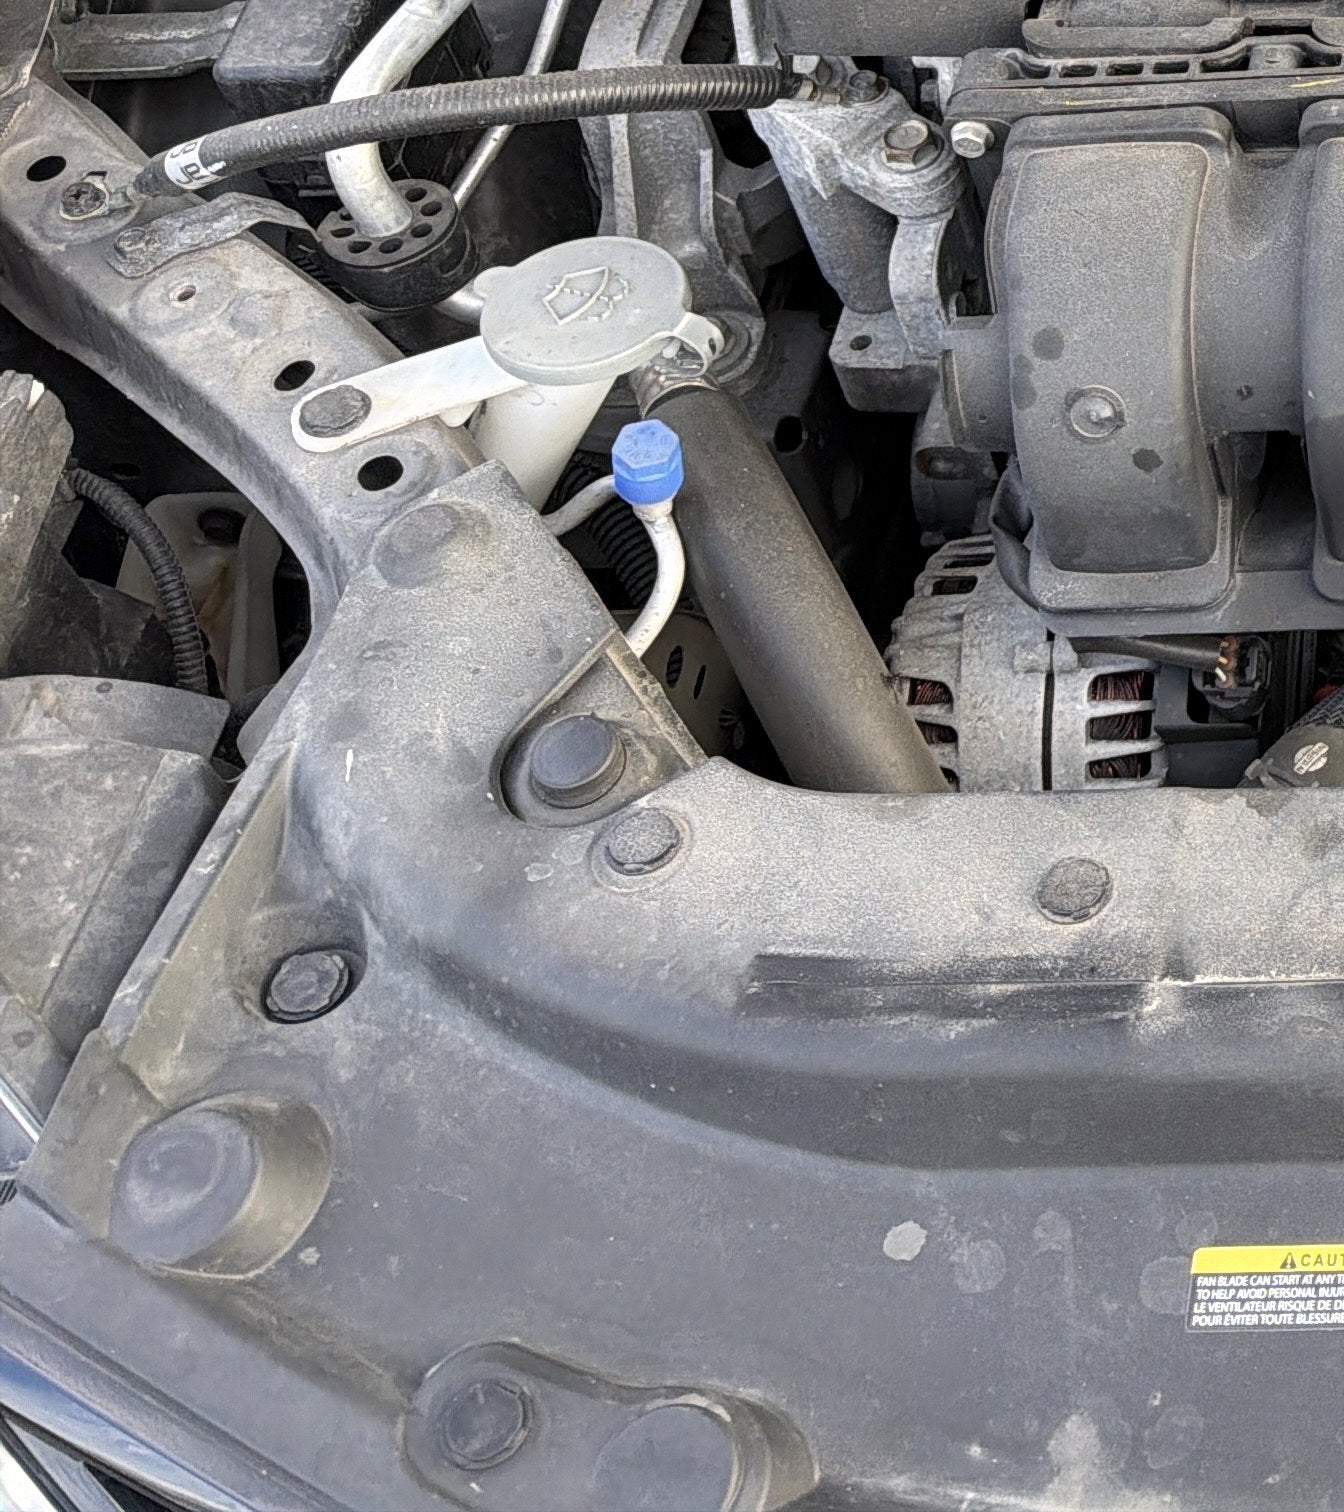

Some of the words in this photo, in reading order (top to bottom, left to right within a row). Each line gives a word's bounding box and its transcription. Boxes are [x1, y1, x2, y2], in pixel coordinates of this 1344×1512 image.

[1197, 1276, 1216, 1286] FAN
[1218, 1276, 1249, 1286] BLADE
[1250, 1275, 1271, 1285] CAN
[1272, 1275, 1300, 1285] START
[1302, 1274, 1313, 1284] AT
[1315, 1274, 1336, 1284] ANY
[1197, 1289, 1210, 1299] TO
[1211, 1289, 1234, 1299] HELP
[1236, 1288, 1267, 1299] AVOID
[1268, 1288, 1317, 1298] PERSONAL
[1194, 1302, 1207, 1313] LE
[1208, 1301, 1276, 1312] VENTILATEUR
[1278, 1300, 1315, 1311] RISQUE
[1317, 1300, 1332, 1310] DE
[1192, 1314, 1222, 1326] POUR
[1224, 1313, 1259, 1325] ÉVITER
[1261, 1314, 1295, 1325] TOUTE
